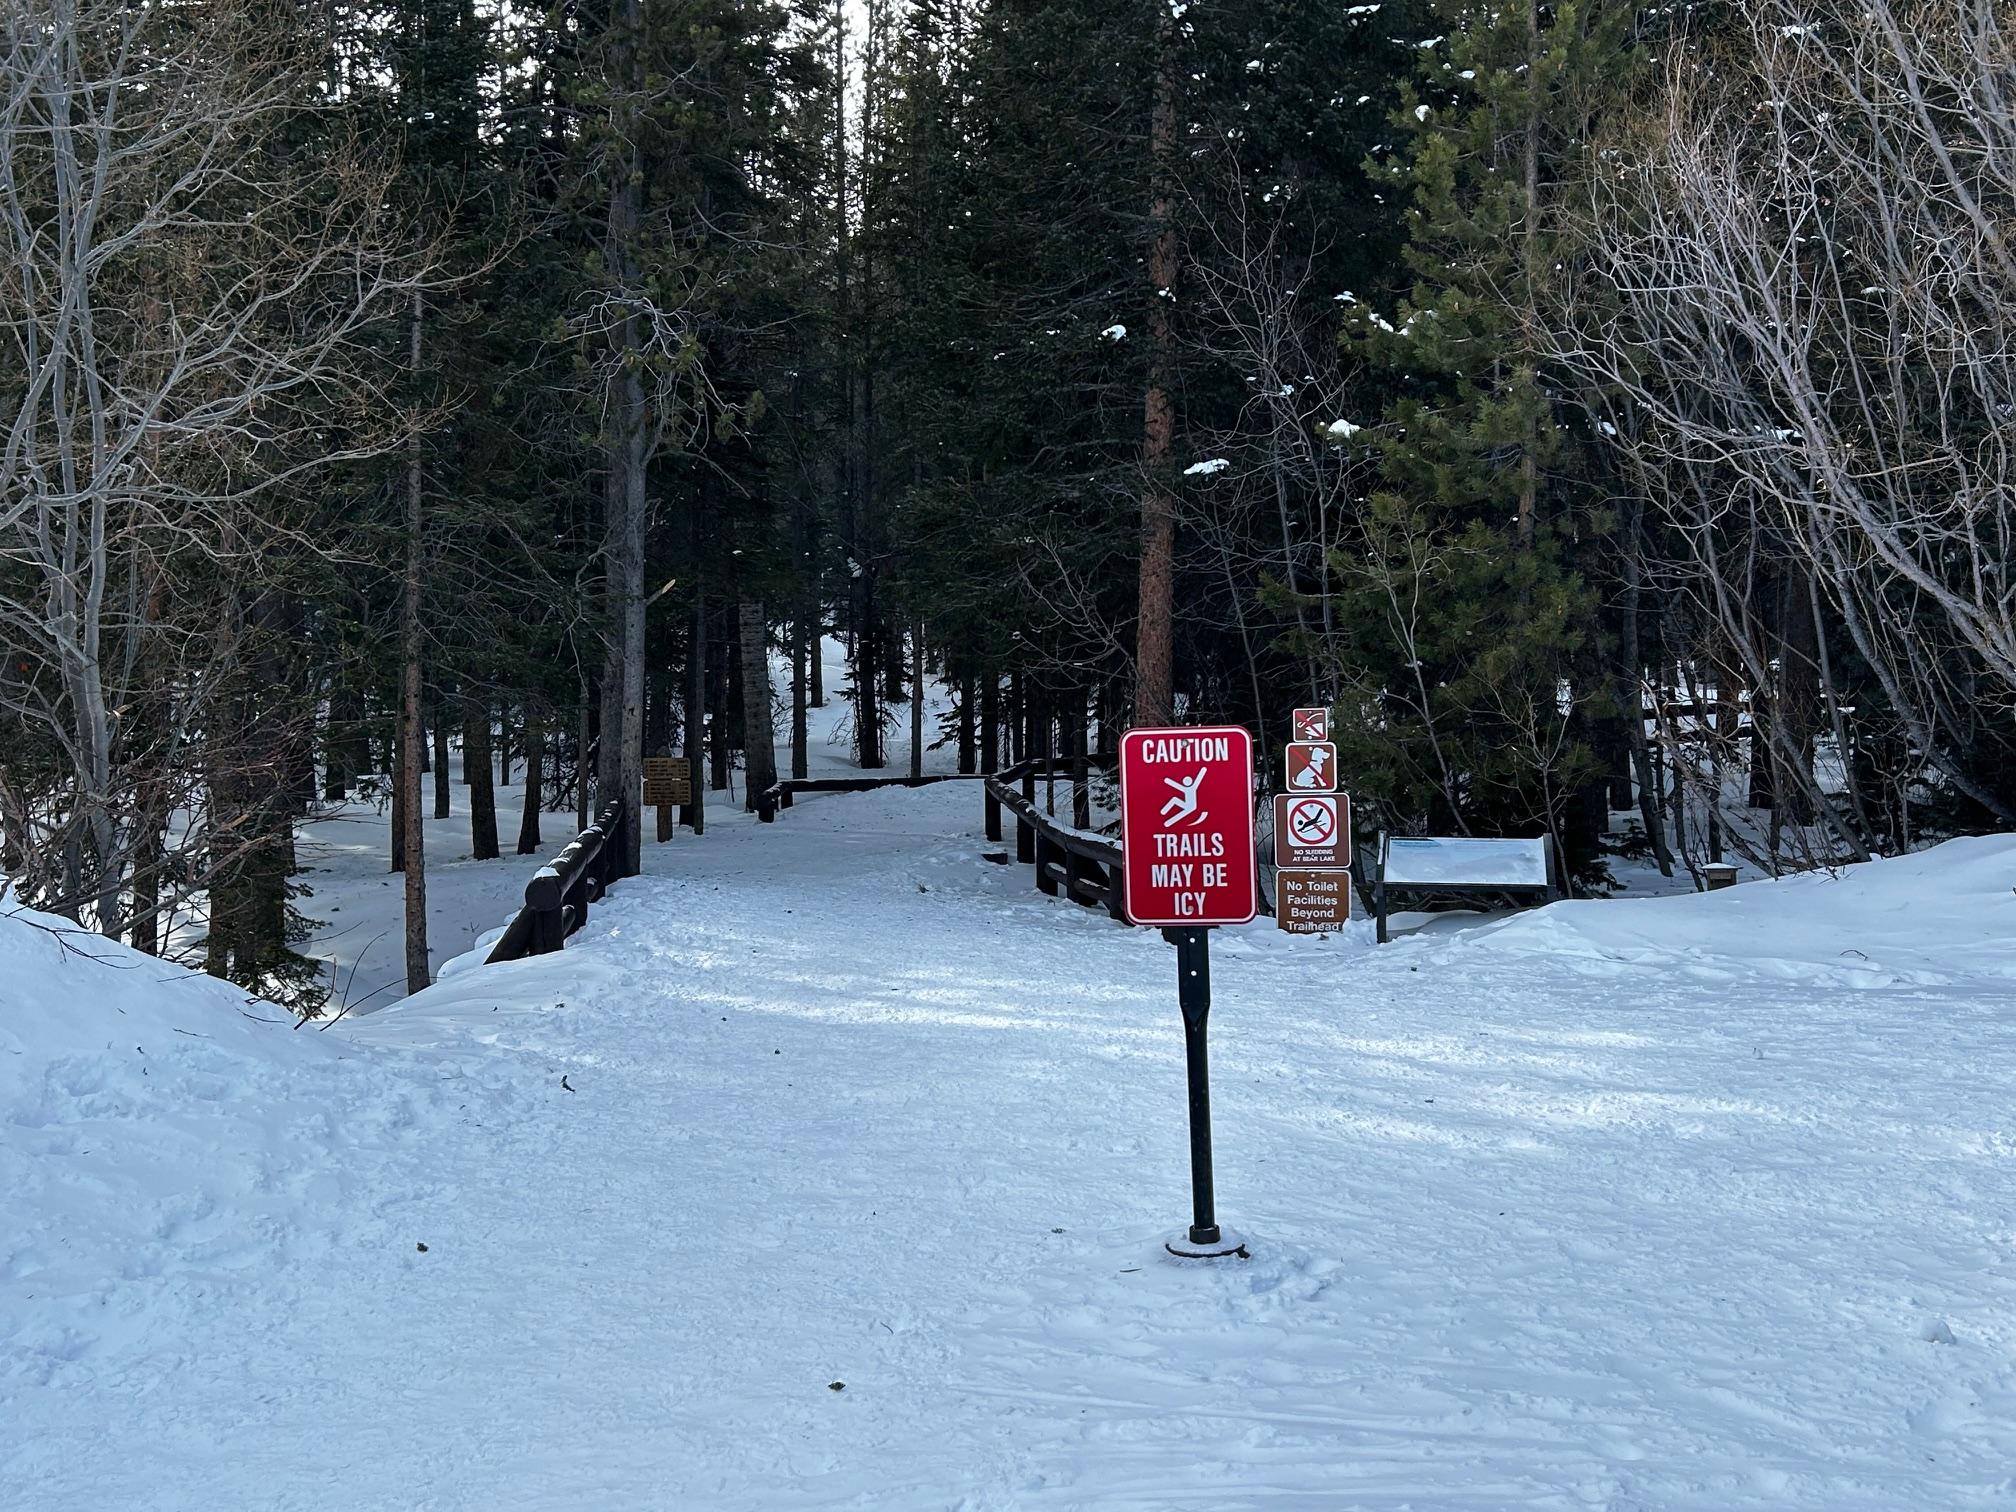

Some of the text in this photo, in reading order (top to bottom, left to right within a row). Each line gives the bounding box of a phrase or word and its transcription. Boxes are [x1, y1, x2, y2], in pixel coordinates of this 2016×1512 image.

[1142, 737, 1229, 763] CAUTION
[1153, 832, 1224, 858] TRAILS
[1152, 863, 1228, 888] MAY BE
[1286, 881, 1338, 891] No Toilet
[1174, 892, 1206, 916] ICY
[1287, 894, 1338, 905] Facilities
[1291, 907, 1334, 919] Beyond
[1286, 921, 1340, 931] Trailhead
